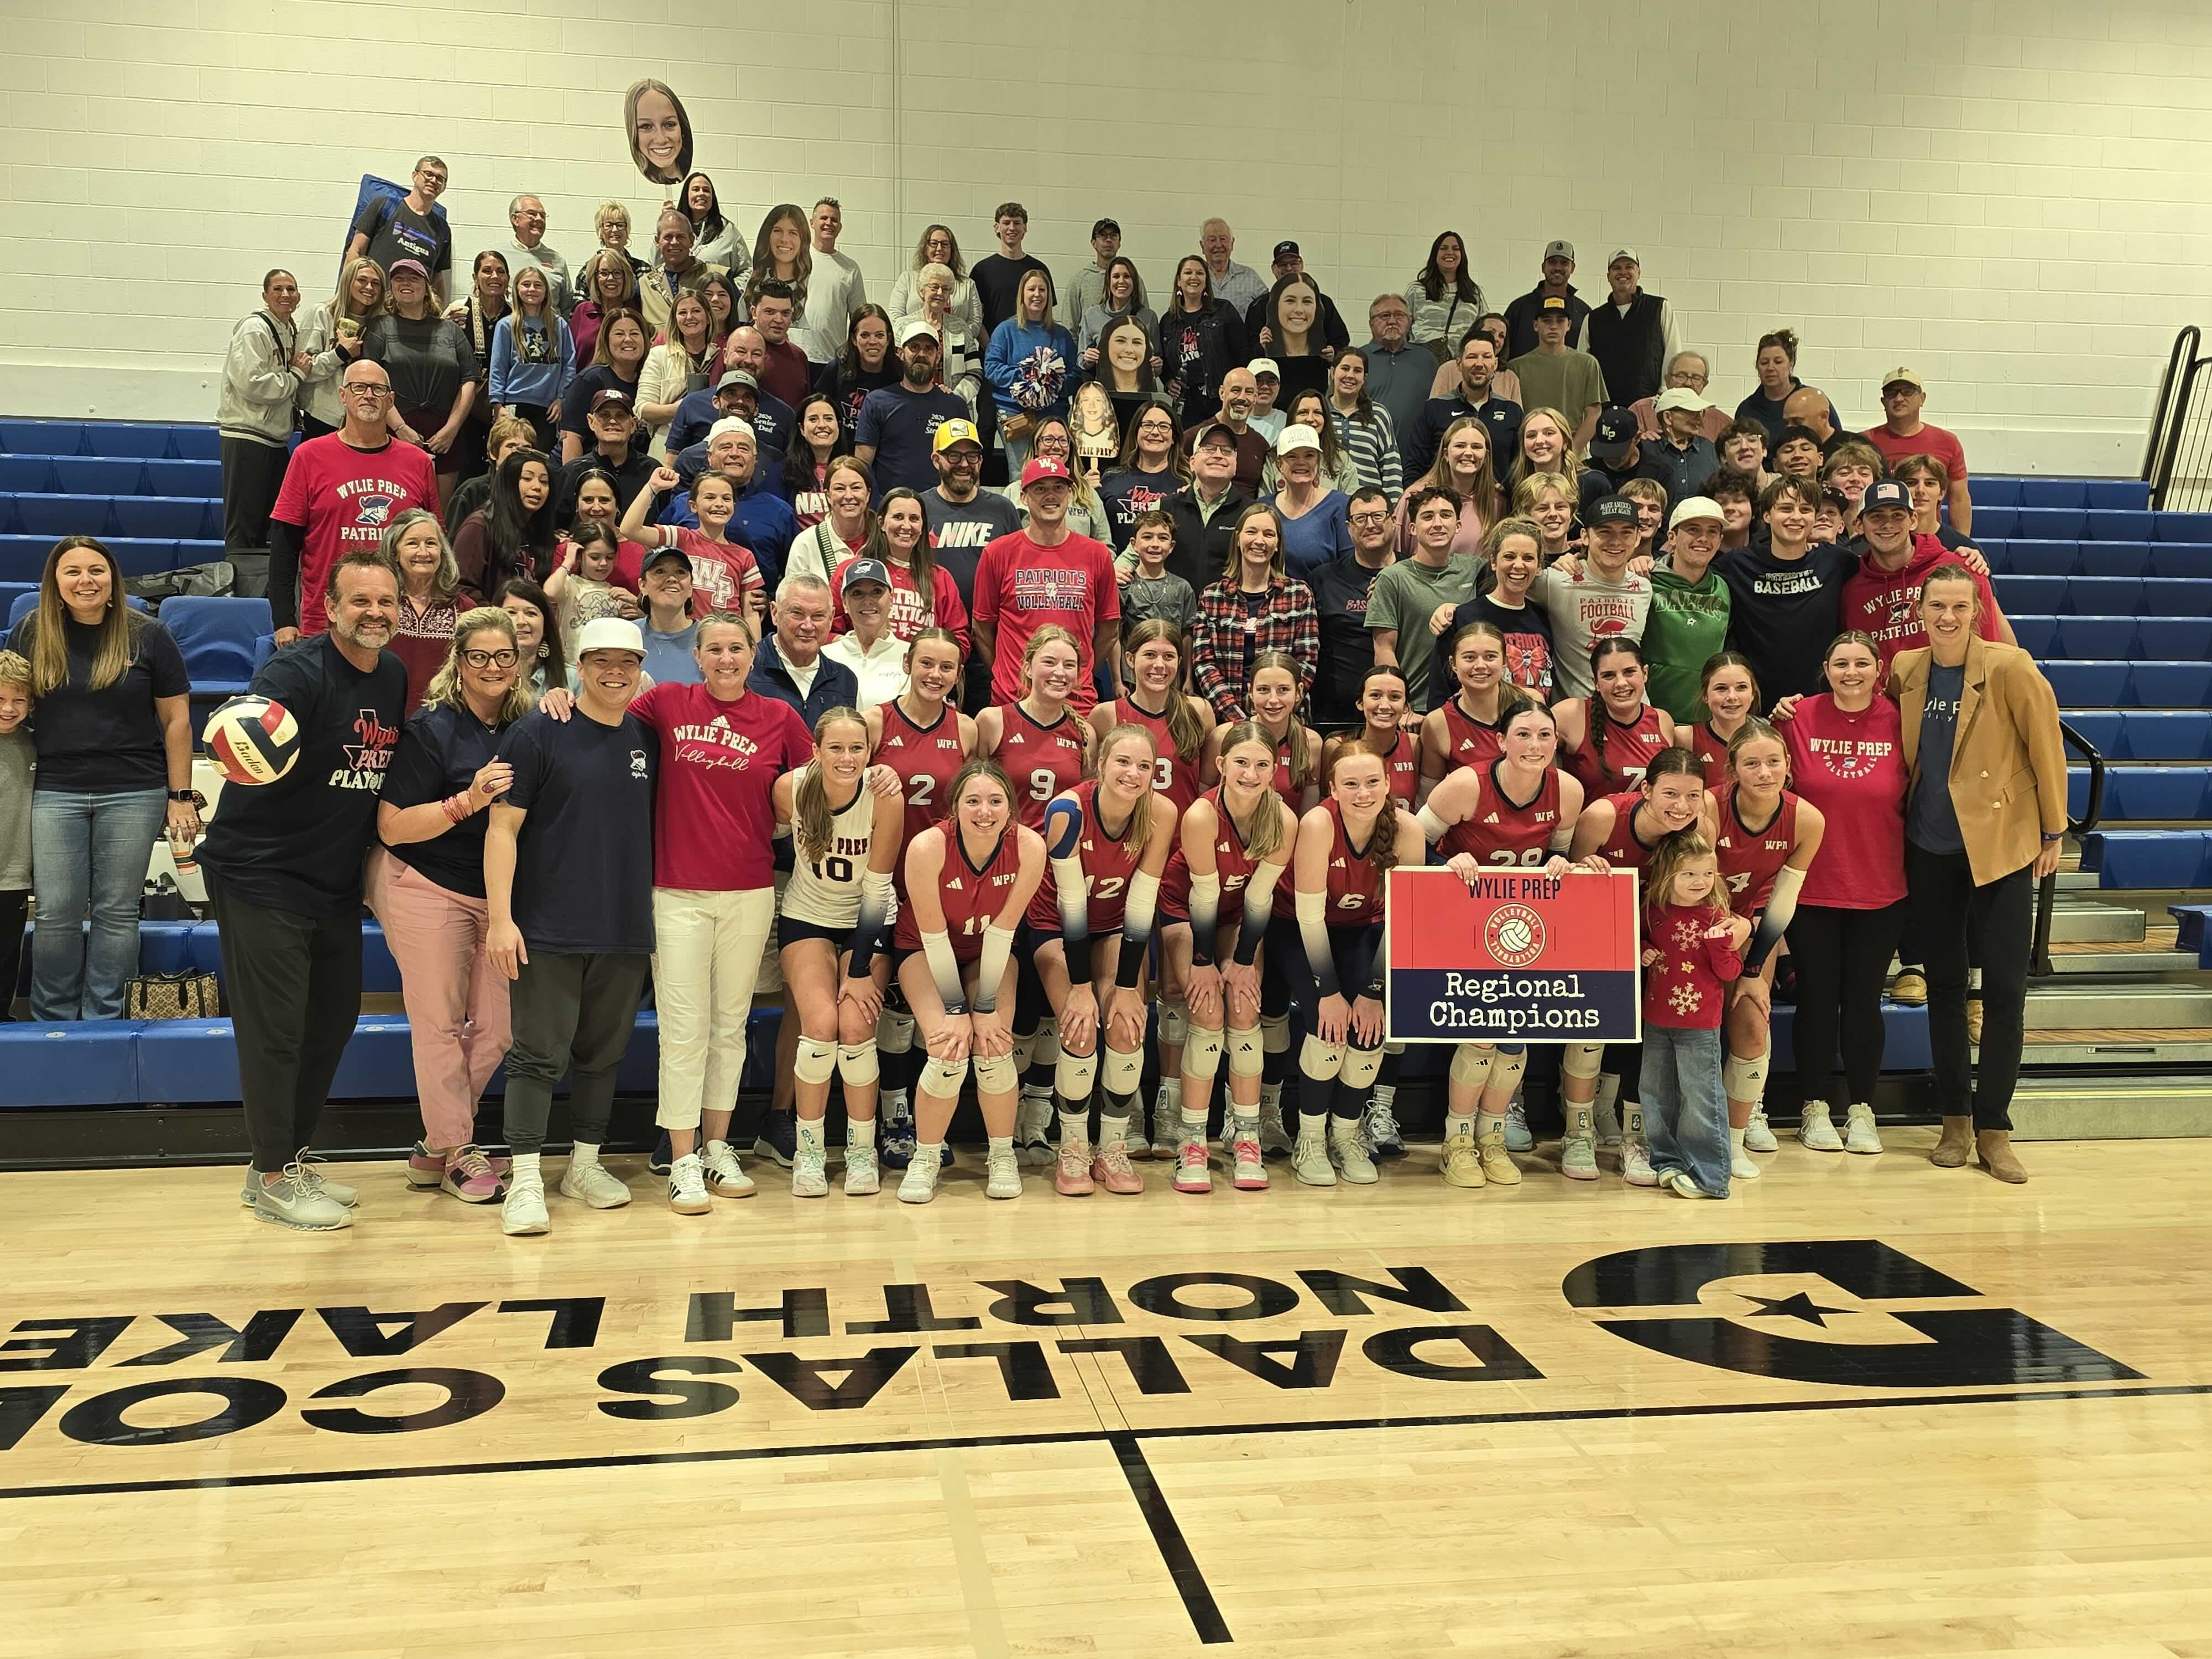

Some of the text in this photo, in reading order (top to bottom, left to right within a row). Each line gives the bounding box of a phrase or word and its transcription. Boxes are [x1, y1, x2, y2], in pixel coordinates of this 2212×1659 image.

[753, 418, 777, 426] Senior
[758, 424, 773, 433] Dad
[1038, 458, 1058, 473] WP
[336, 478, 408, 500] WYLIE PREP
[795, 492, 831, 517] NAT
[1600, 500, 1632, 510] MAKE AMERICA
[1618, 507, 1631, 515] AGAIN
[341, 526, 383, 541] PATRI
[937, 521, 994, 548] NIKE
[689, 555, 734, 608] WP
[1015, 569, 1087, 585] PATRIOTS
[1754, 576, 1823, 594] BASEBALL
[1764, 570, 1814, 581] PATRIOTS
[1016, 594, 1084, 611] VOLLEYBALL
[1655, 589, 1722, 621] DALLAS
[1863, 586, 1922, 614] WYLIE PR
[890, 604, 935, 628] ATION
[1580, 603, 1637, 622] FOOTBALL
[1871, 619, 1927, 641] PATRIOT
[353, 718, 399, 751] Wyli
[672, 725, 759, 756] WYLIE PREP
[937, 739, 958, 750] WPA
[1056, 737, 1078, 749] WPA
[1640, 733, 1661, 743] WPA
[234, 741, 264, 774] Baden
[674, 744, 749, 771] Volleyball
[1810, 738, 1892, 757] WYLIE PREP
[1394, 761, 1414, 774] WPA
[1823, 755, 1877, 779] VOLLEYBALL
[908, 774, 936, 805] 2
[1029, 768, 1056, 801] 9
[1623, 766, 1647, 793] 7
[837, 837, 869, 856] PREP
[1765, 840, 1788, 851] WPA
[812, 855, 853, 882] 10
[1084, 875, 1125, 899] 12
[1469, 878, 1561, 900] WYLIE PREP
[1725, 872, 1752, 893] 4
[1337, 893, 1365, 909] 6
[962, 914, 992, 935] 11
[1490, 908, 1540, 930] VOLLEYBALL
[1491, 940, 1541, 963] VOLLEYBALL
[1444, 973, 1585, 1003] Regional
[1430, 1001, 1600, 1035] Champions
[685, 1267, 1471, 1342] NORTH
[0, 1324, 1548, 1451] DALLAS CO
